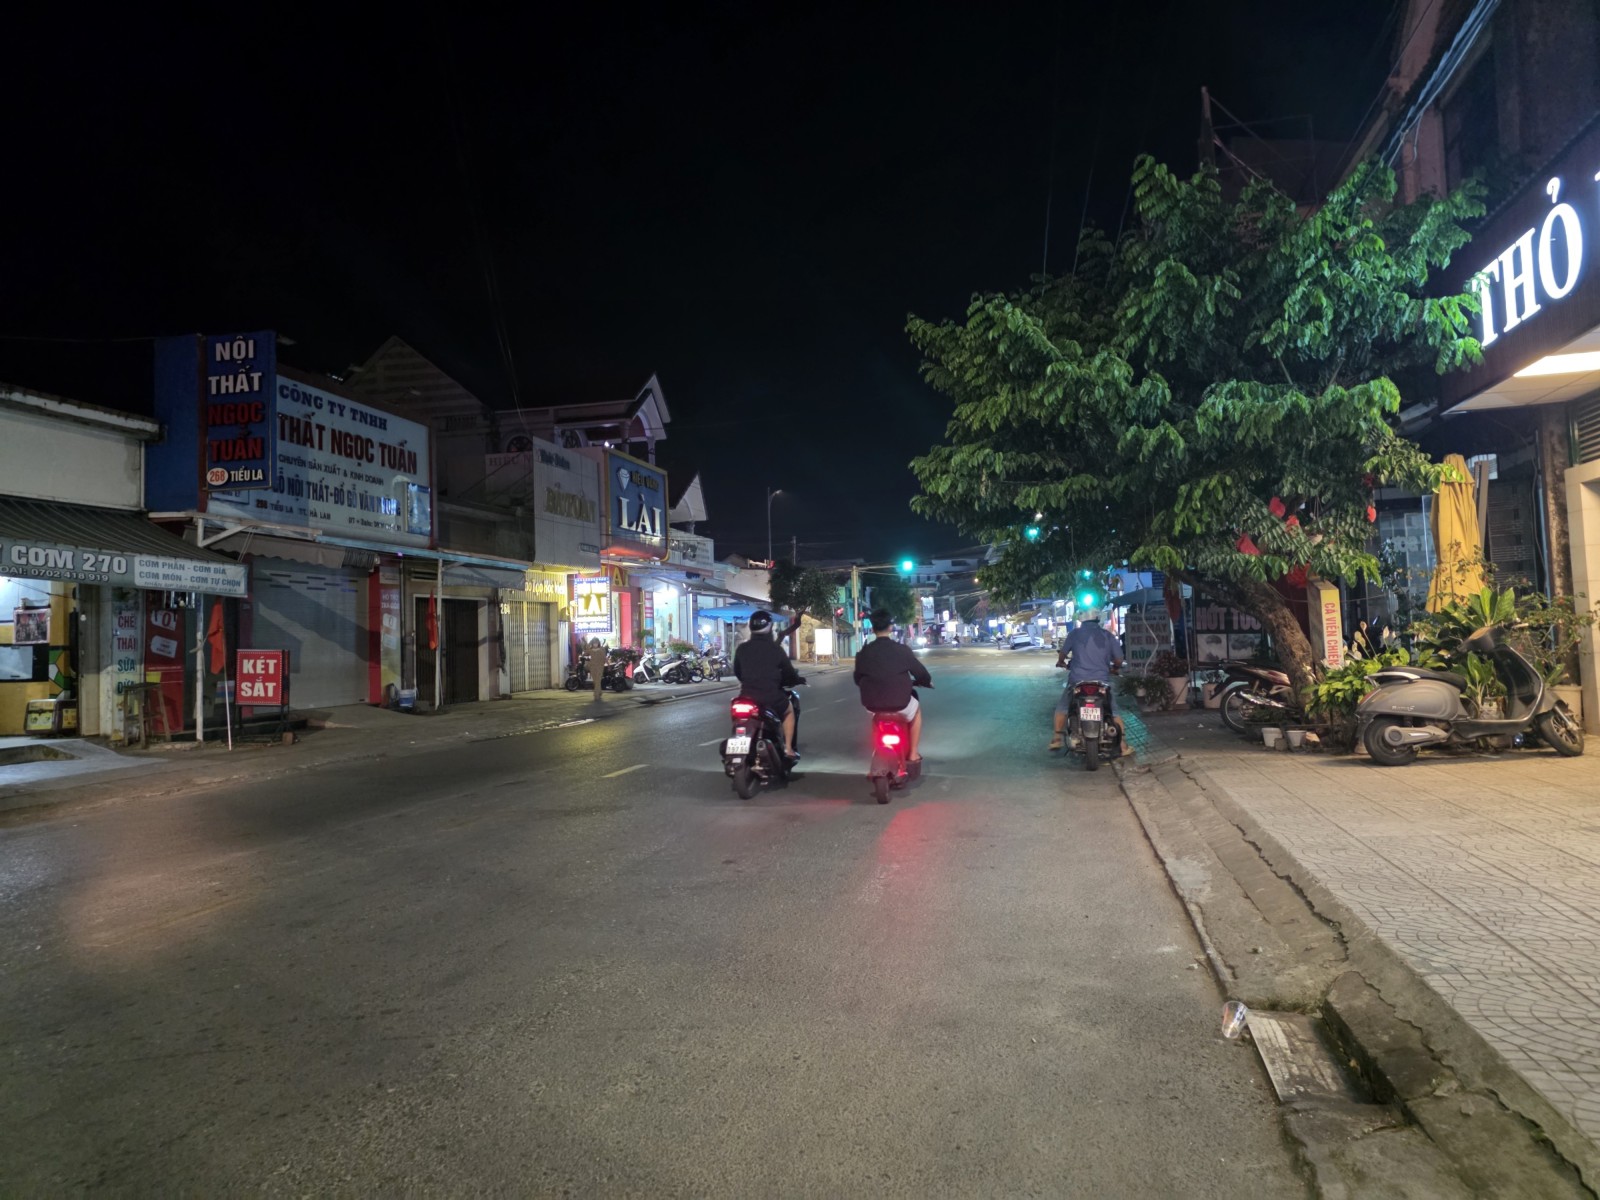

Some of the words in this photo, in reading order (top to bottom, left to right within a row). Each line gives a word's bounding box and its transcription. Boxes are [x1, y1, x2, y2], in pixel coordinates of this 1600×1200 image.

[1471, 177, 1582, 347] THỎ
[215, 335, 254, 364] NỘI
[208, 365, 262, 395] THẤT
[208, 401, 263, 428] NGỌC
[278, 383, 323, 409] CÔNG
[327, 401, 346, 418] TY
[350, 408, 388, 430] TNHH
[210, 430, 263, 462] TUẤN
[277, 411, 325, 450] THẤT
[330, 428, 375, 467] NGỌC
[378, 439, 417, 475] TUẤN
[209, 470, 226, 482] 268
[230, 466, 251, 482] TIỂU
[251, 468, 263, 480] LA
[278, 454, 306, 468] CHUYÊN
[308, 458, 323, 472] SẢN
[323, 462, 340, 476] XUẤT
[350, 471, 364, 482] KINH
[365, 474, 384, 486] DOANH
[288, 474, 304, 501] NỘI
[619, 493, 662, 537] LÀI
[11, 545, 74, 570] CƠM
[82, 553, 128, 574] 270
[139, 559, 160, 568] CƠM
[193, 564, 211, 573] CƠM
[31, 568, 61, 578] 0702
[64, 571, 85, 580] 418
[88, 573, 109, 582] 919
[139, 571, 160, 580] CƠM
[162, 572, 182, 582] MÓN
[190, 575, 209, 584] CƠM
[210, 577, 220, 586] TỰ
[221, 578, 241, 588] CHỌN
[1326, 617, 1339, 637] VIÊN
[117, 635, 136, 650] THÁI
[242, 656, 277, 674] KÉT
[241, 676, 277, 697] SẮT
